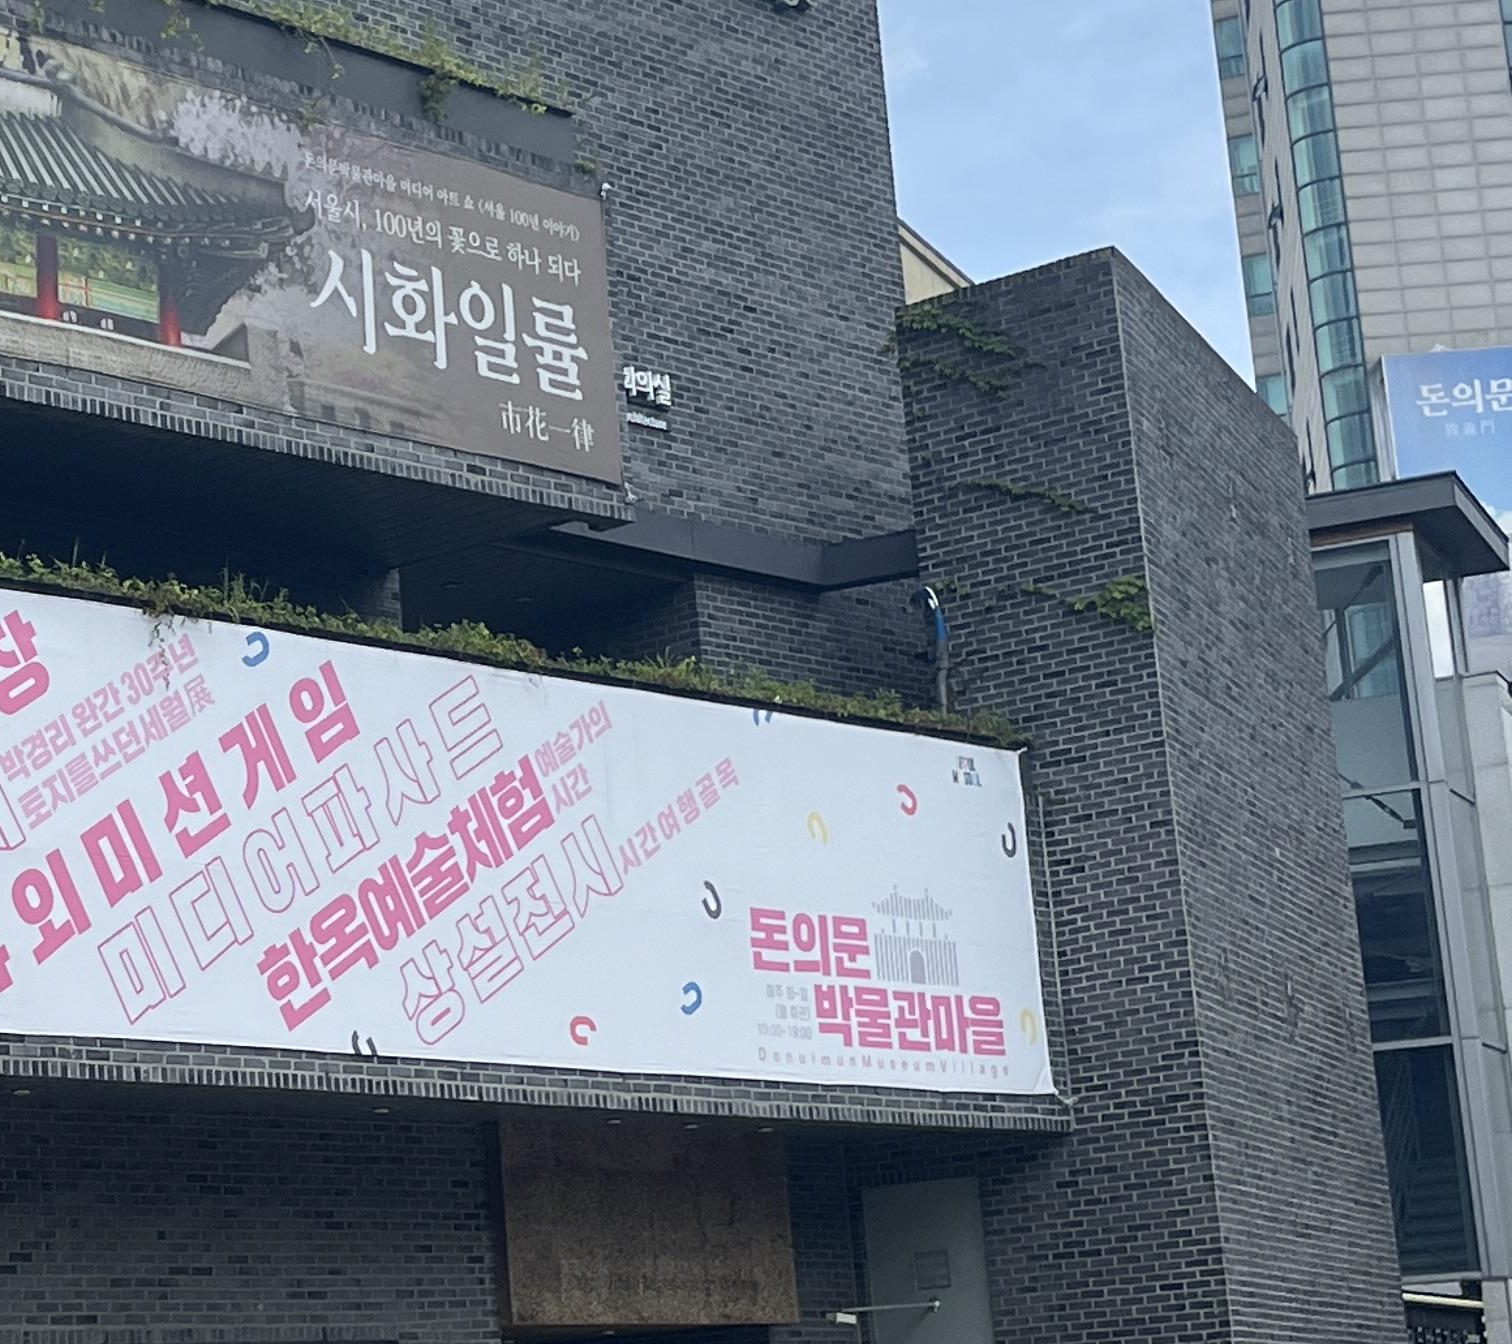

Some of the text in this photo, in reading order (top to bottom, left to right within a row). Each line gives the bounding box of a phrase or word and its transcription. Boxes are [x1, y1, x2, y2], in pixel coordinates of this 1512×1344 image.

[304, 188, 582, 288] 서울시, 100년의 꽃으로 하나 되다
[508, 207, 540, 233] 100년
[310, 247, 589, 401] 시화일률
[499, 400, 595, 453] 市花一律
[70, 681, 126, 739] 완간
[119, 632, 200, 706] 30주년
[533, 699, 614, 778] 예술가의
[551, 762, 594, 815] 시간
[256, 753, 556, 1032] 한옥예술체험
[399, 813, 625, 1046] 상설전시
[749, 906, 872, 980] 돈의문
[813, 983, 1007, 1057] 박물관마을
